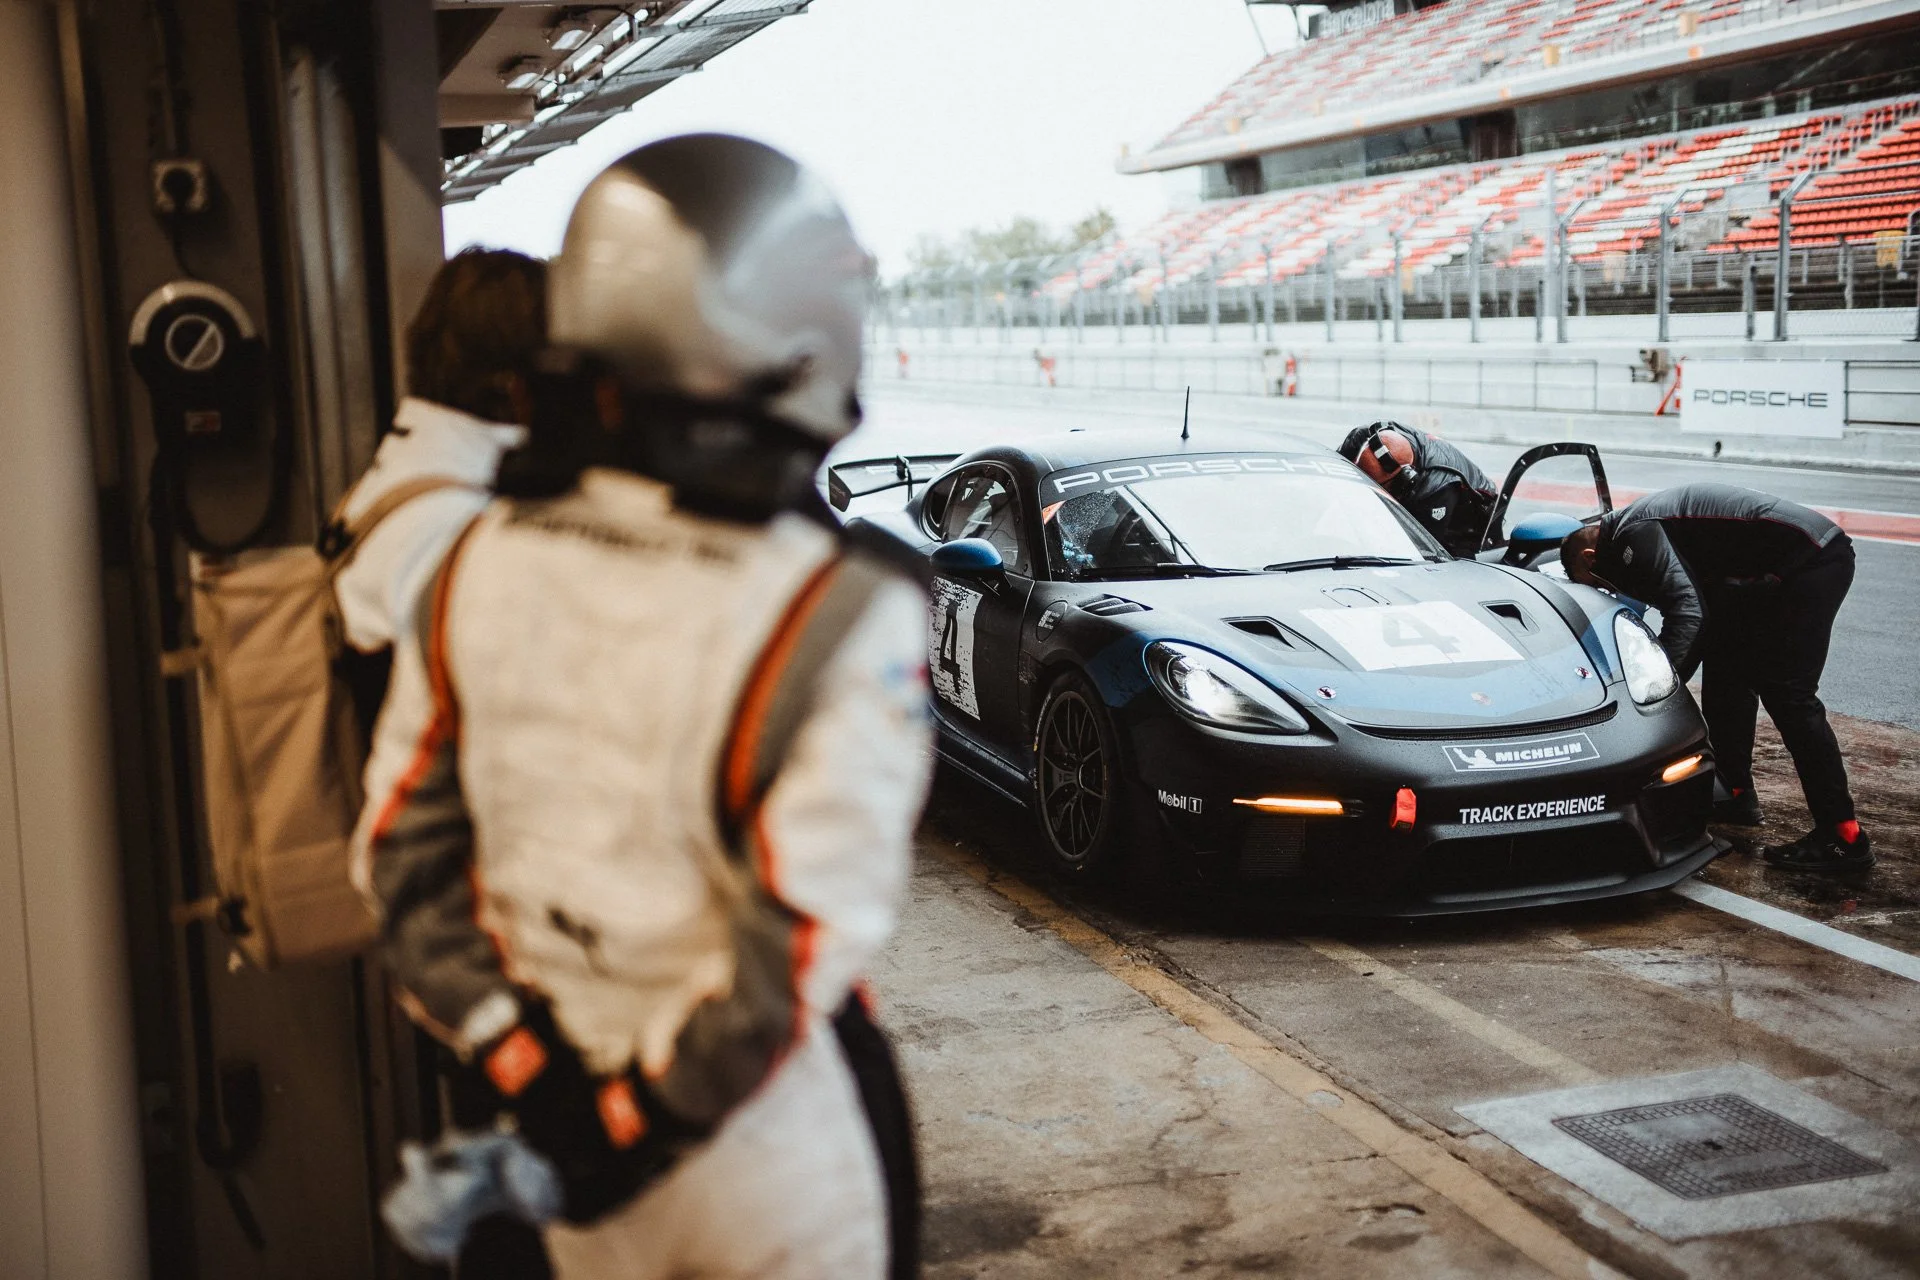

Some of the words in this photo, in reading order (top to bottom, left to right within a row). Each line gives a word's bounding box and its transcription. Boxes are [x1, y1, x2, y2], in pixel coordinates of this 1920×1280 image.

[1693, 389, 1829, 408] PORSCHE
[1052, 458, 1364, 494] PORSCHE
[938, 599, 962, 696] 4
[1381, 611, 1462, 654] 4
[1495, 742, 1583, 763] MICHELIN
[1157, 789, 1187, 810] Mobil
[1459, 804, 1515, 825] TRACK
[1516, 795, 1606, 820] EXPERIENCE
